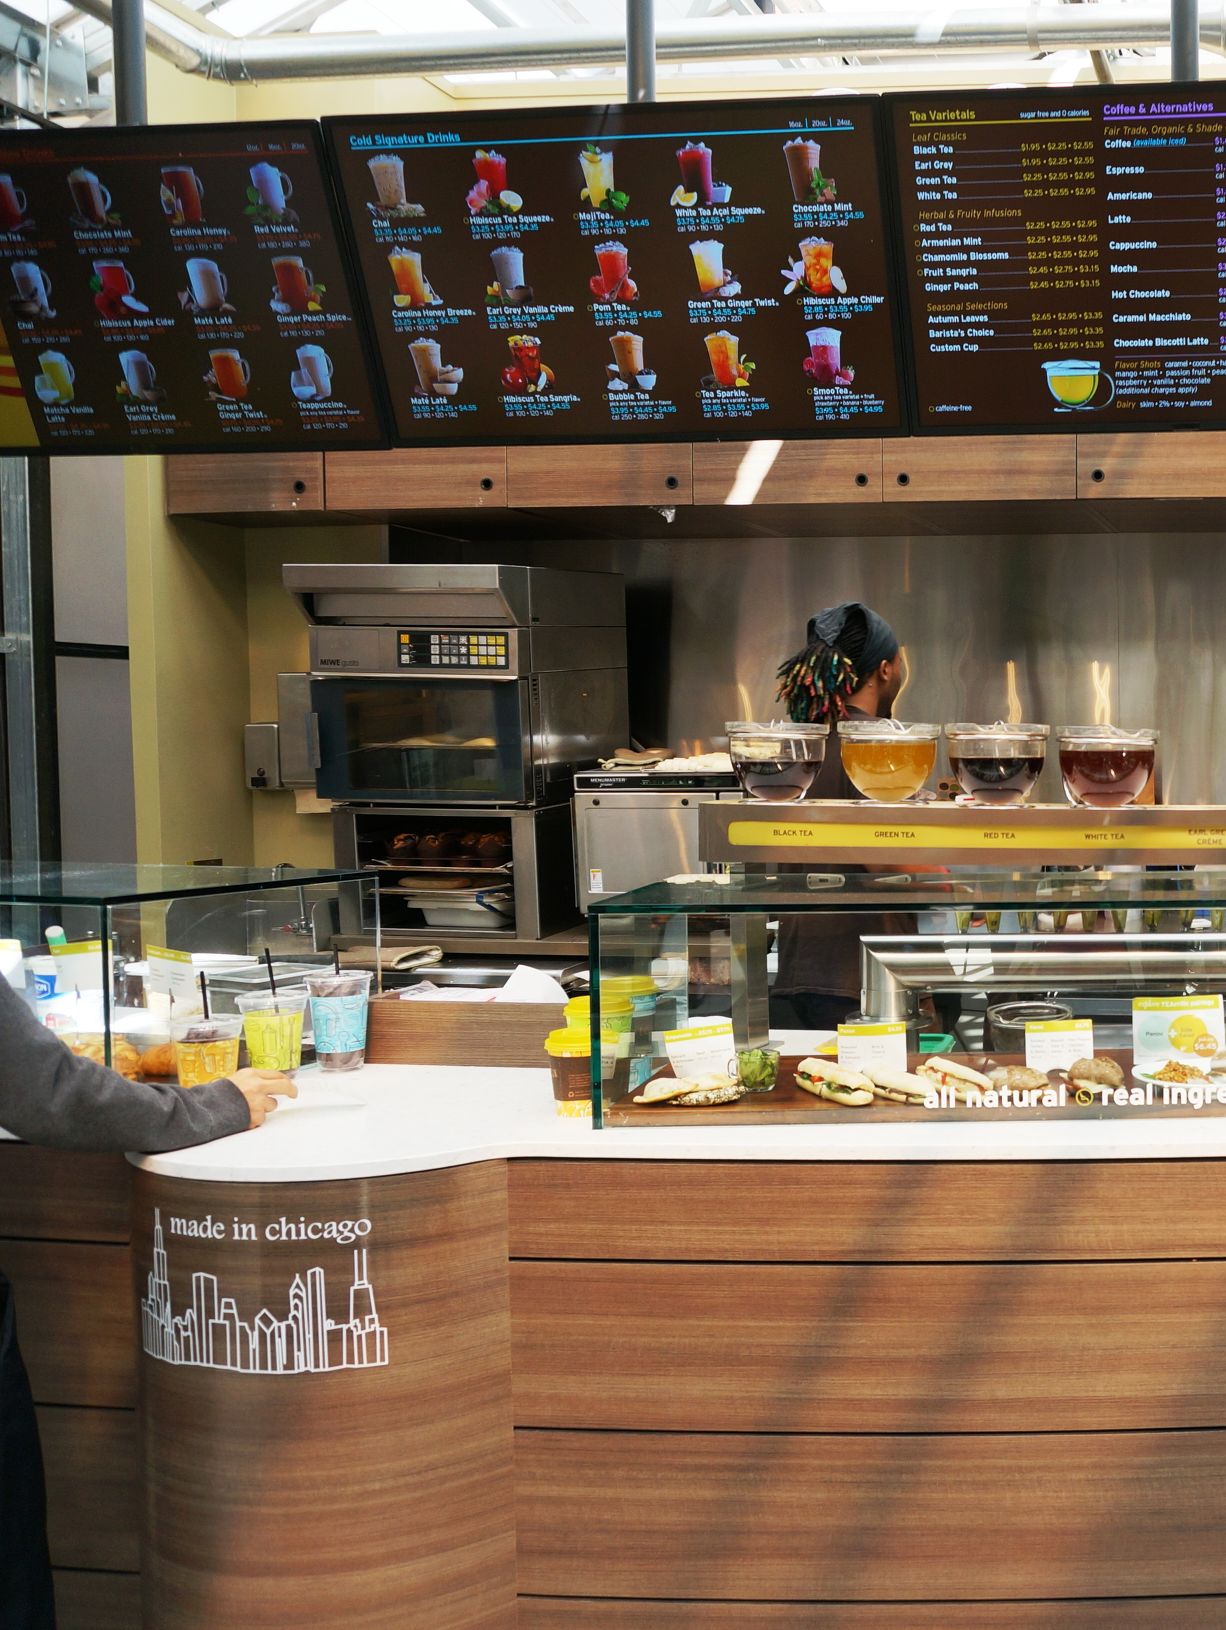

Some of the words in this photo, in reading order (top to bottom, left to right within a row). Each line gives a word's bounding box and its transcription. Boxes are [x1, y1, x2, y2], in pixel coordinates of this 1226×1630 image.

[1104, 104, 1136, 115] Coffee
[1139, 104, 1146, 114] &
[1150, 102, 1213, 113] Alternatives
[910, 111, 927, 121] Tea
[930, 109, 975, 120] Varietals
[1104, 126, 1121, 136] Fair
[1124, 126, 1149, 135] Trade,
[1151, 125, 1185, 135] Organic
[1188, 124, 1193, 133] &
[1196, 123, 1223, 132] Shade
[350, 135, 373, 146] Cold
[375, 133, 425, 147] Signature
[427, 131, 461, 143] Drinks
[912, 132, 931, 142] Leaf
[933, 131, 967, 141] Classics
[1105, 139, 1131, 148] Coffee
[913, 146, 937, 155] Black
[939, 145, 953, 154] Tea
[915, 161, 931, 170] Earl
[934, 161, 953, 170] Grey
[1106, 166, 1145, 176] Espresso
[916, 176, 940, 185] Green
[942, 176, 957, 184] Tea
[917, 191, 941, 200] White
[943, 191, 957, 200] Tea
[1107, 191, 1152, 200] Americano
[792, 203, 832, 213] Chocolate
[834, 202, 852, 211] Mint
[1108, 215, 1131, 224] Latte
[921, 238, 961, 247] Armenian
[963, 237, 982, 246] Mint
[1109, 241, 1157, 250] Cappuccino
[1111, 264, 1138, 273] Mocha
[925, 283, 951, 292] Ginger
[954, 282, 978, 290] Peach
[1112, 290, 1127, 299] Hot
[1129, 289, 1170, 298] Chocolate
[593, 304, 611, 312] Pom
[612, 303, 626, 311] Tea
[688, 300, 712, 309] Green
[714, 300, 726, 308] Tea
[728, 299, 752, 309] Ginger
[754, 298, 775, 306] Twist
[1113, 314, 1147, 323] Caramel
[1149, 313, 1191, 322] Macchiato
[1114, 339, 1153, 348] Chocolate
[1187, 338, 1209, 346] Latte
[701, 390, 715, 398] Tea
[716, 389, 745, 398] Sparkle
[924, 1085, 956, 1109] all
[966, 1084, 1066, 1108] natural
[1101, 1086, 1153, 1106] real
[170, 1215, 225, 1239] made
[233, 1217, 257, 1240] in
[265, 1216, 372, 1244] chicago
